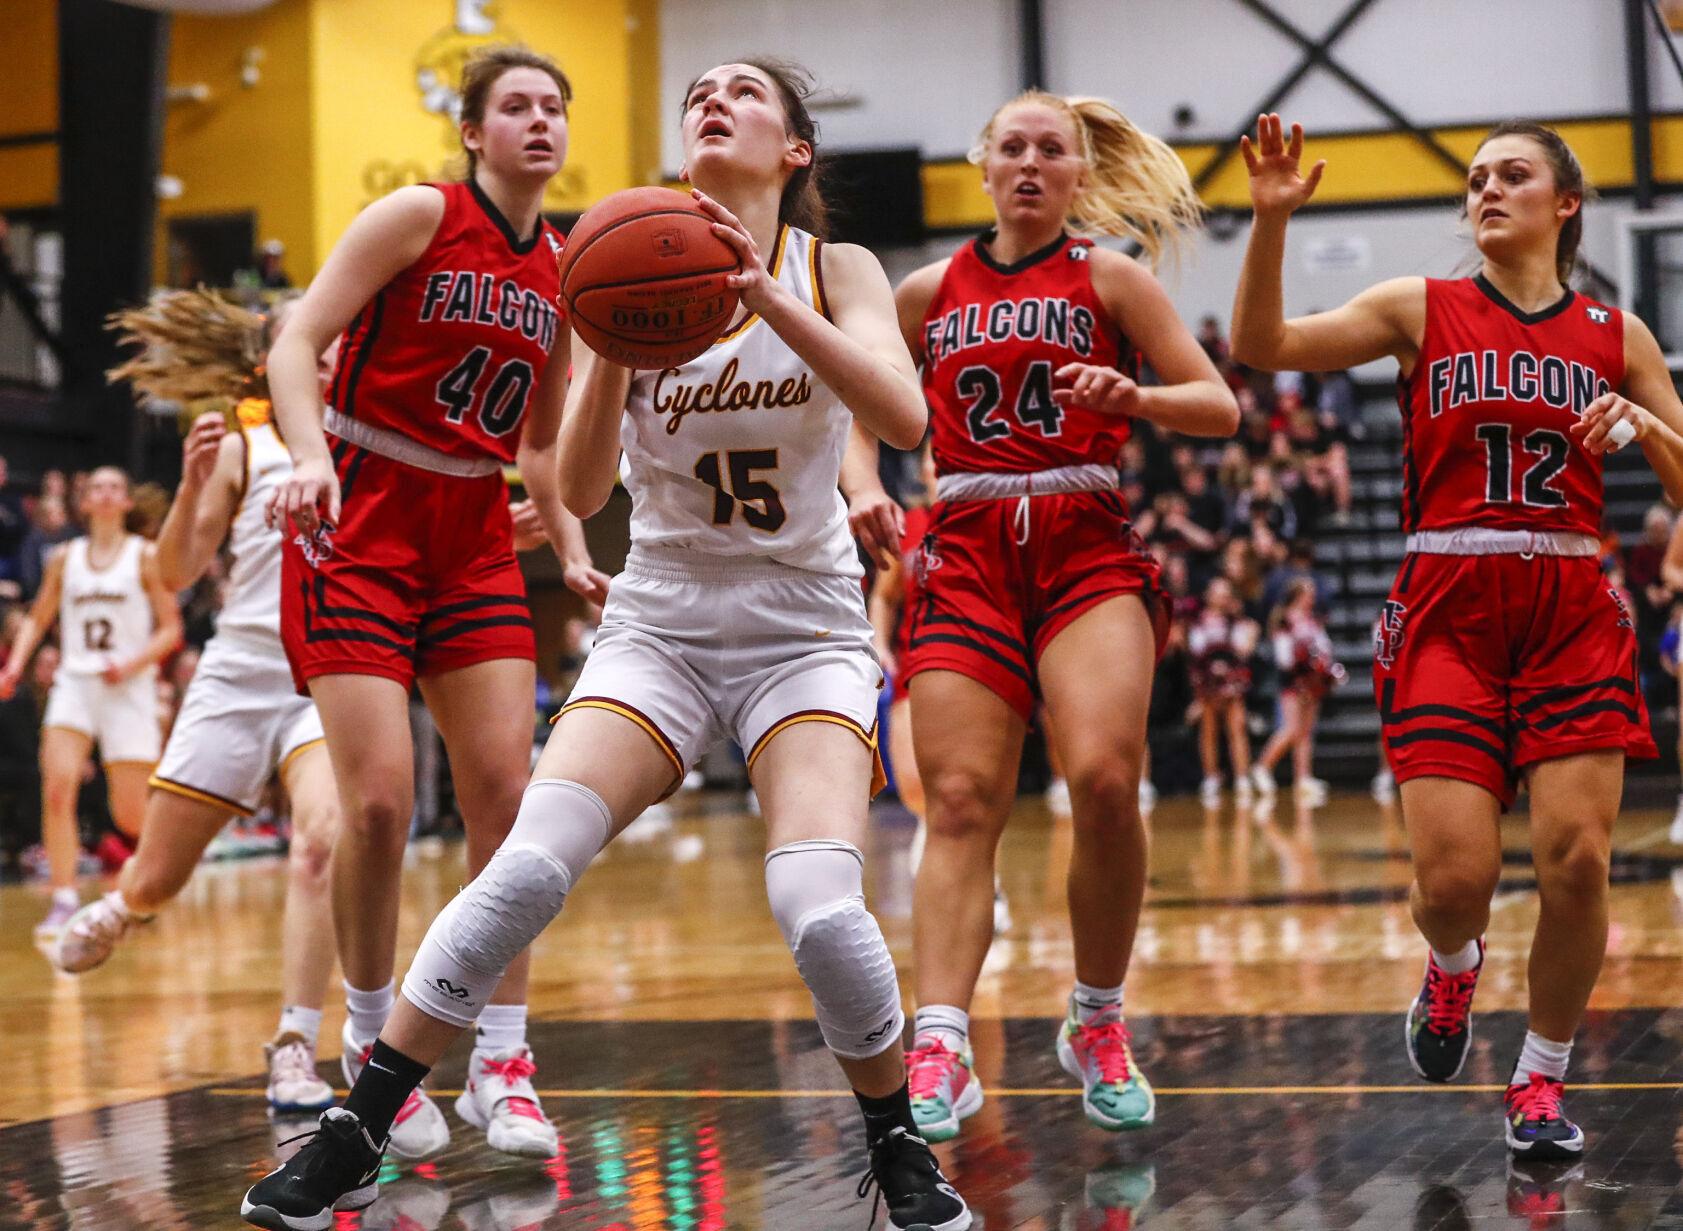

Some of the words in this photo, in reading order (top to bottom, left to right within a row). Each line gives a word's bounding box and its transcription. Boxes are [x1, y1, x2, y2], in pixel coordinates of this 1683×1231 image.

[926, 297, 1094, 371] FALCONS
[435, 345, 534, 438] 40
[653, 357, 812, 436] Cyclones
[956, 361, 1065, 444] 24
[693, 448, 787, 534] 15
[1475, 422, 1569, 509] 12
[84, 617, 113, 651] 12
